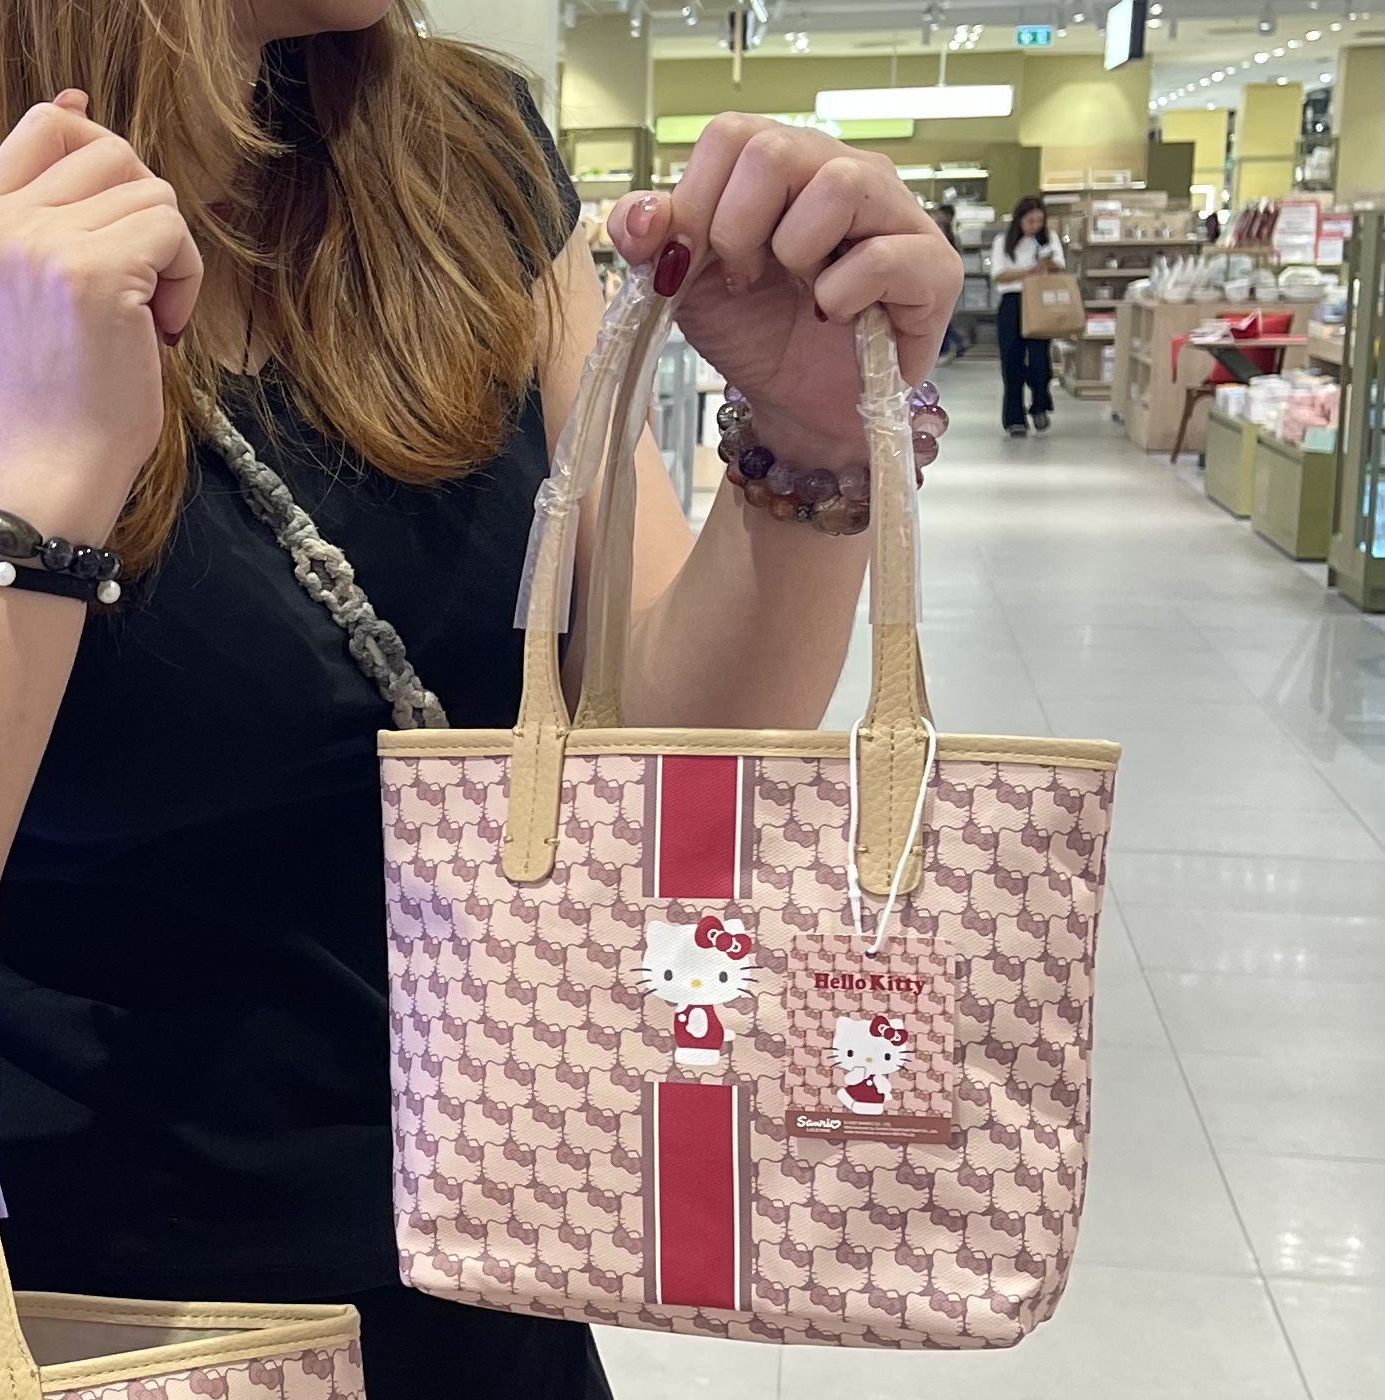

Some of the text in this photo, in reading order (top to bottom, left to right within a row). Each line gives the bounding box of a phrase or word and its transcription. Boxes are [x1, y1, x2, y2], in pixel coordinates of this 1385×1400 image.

[814, 973, 927, 996] Hello Kitty
[797, 1115, 842, 1130] Sanrio
